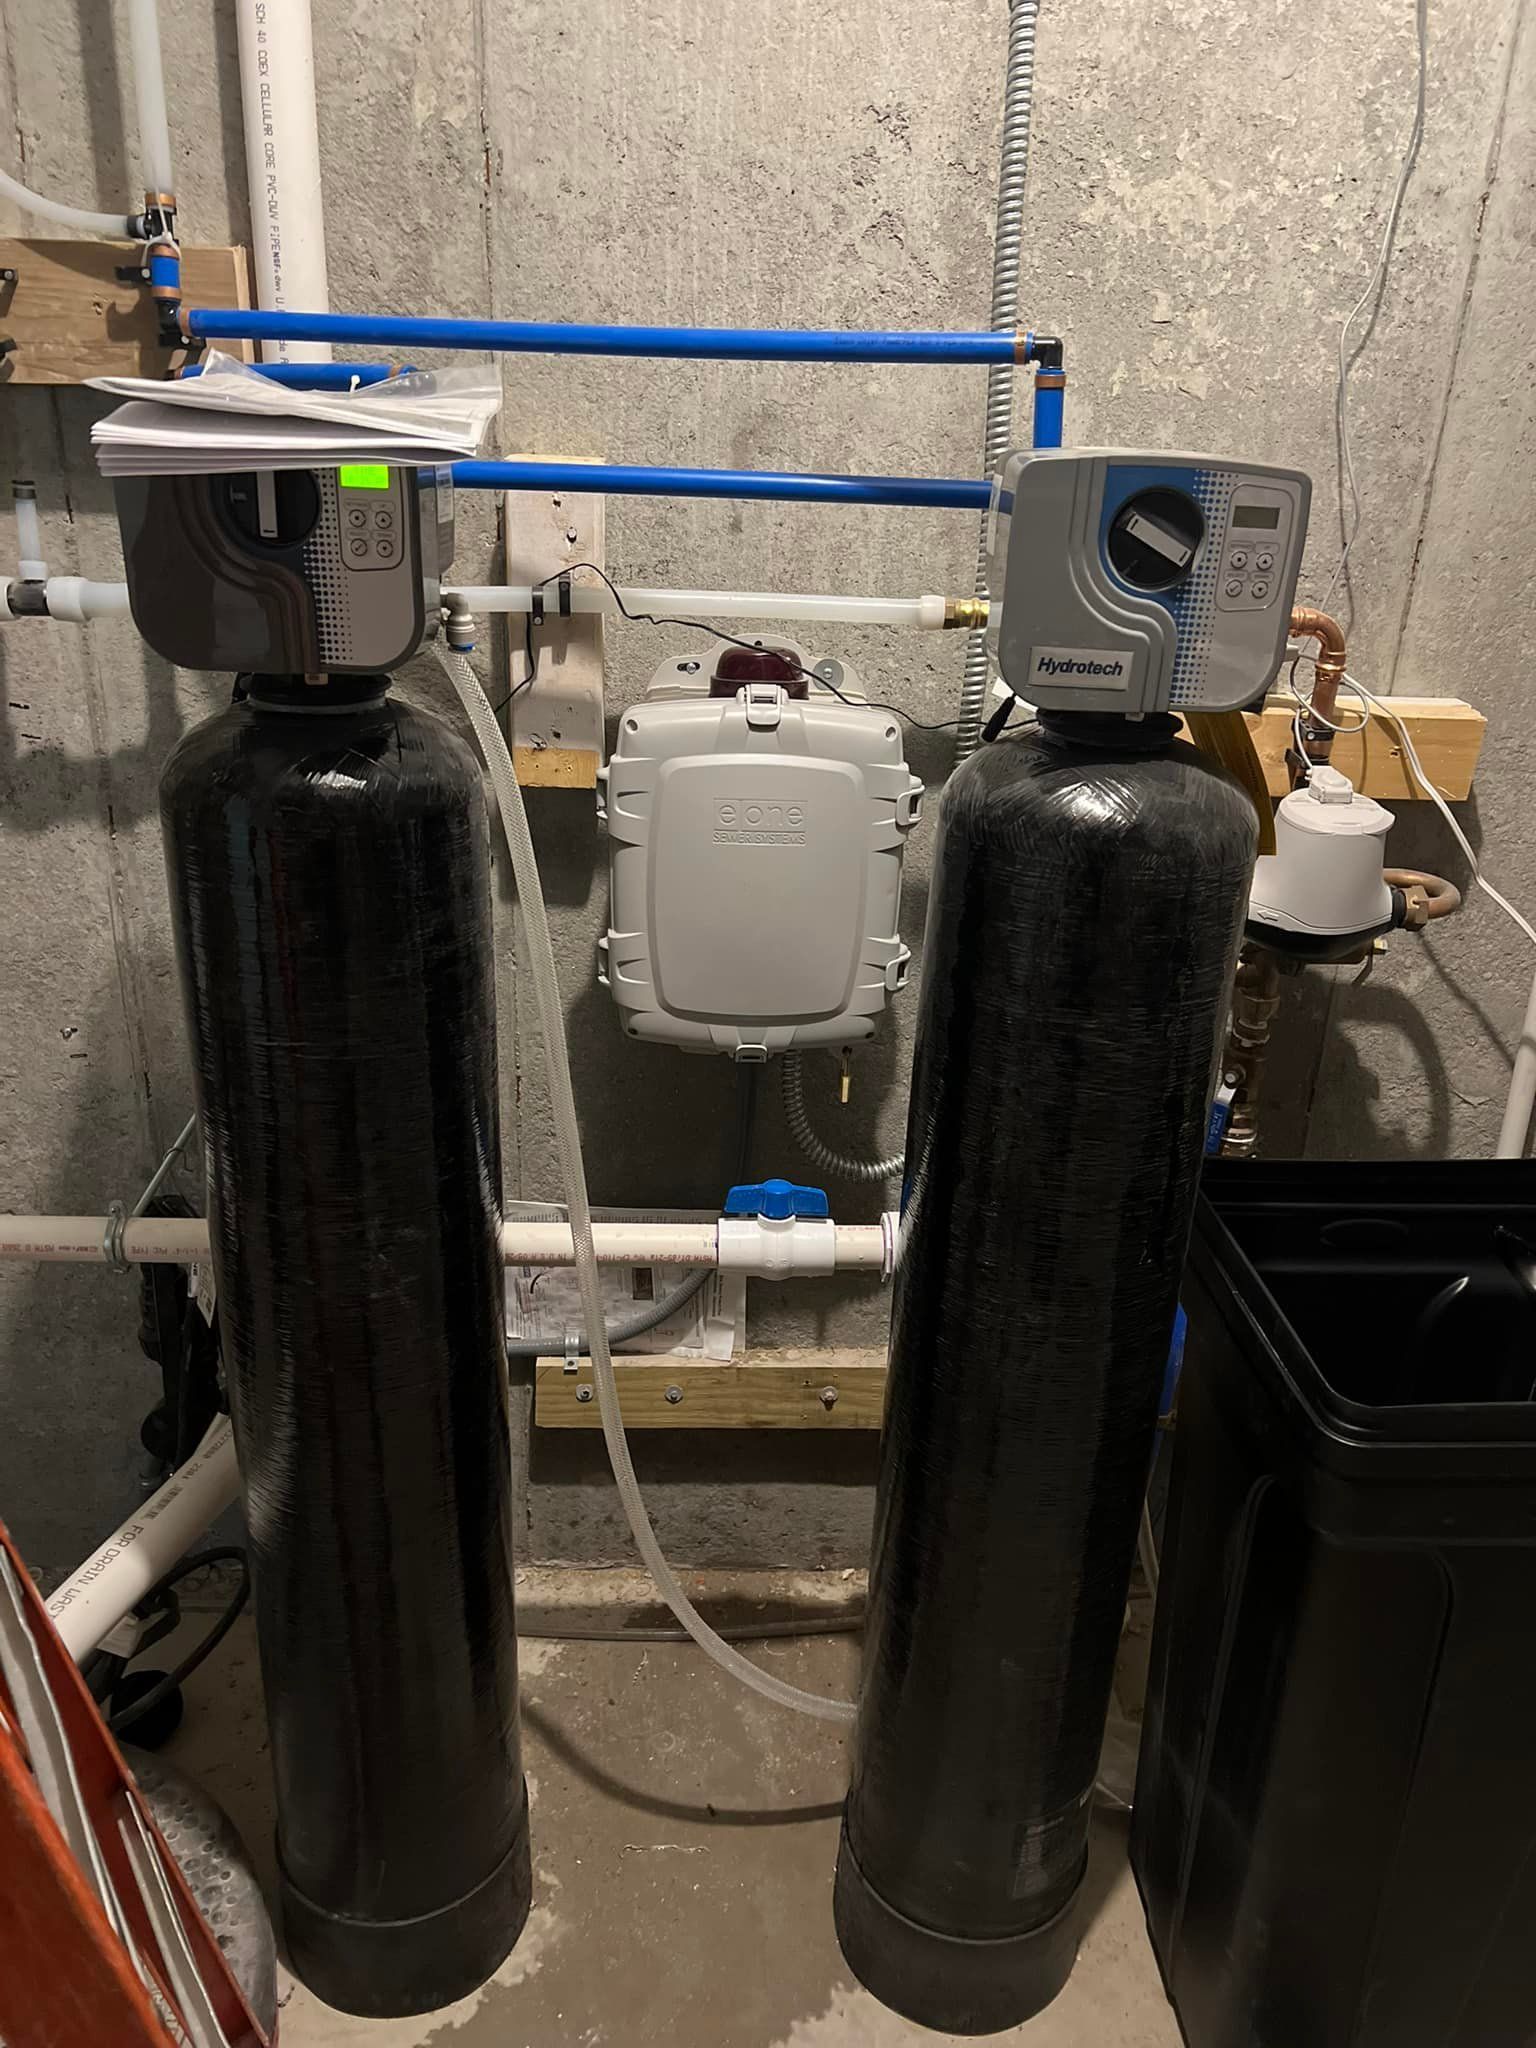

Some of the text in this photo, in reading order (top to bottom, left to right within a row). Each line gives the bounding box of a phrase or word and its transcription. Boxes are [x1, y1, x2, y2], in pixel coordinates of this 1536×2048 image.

[255, 3, 266, 24] SCH
[257, 30, 267, 44] 40
[258, 50, 269, 77] COEX
[260, 83, 274, 137] CELLULAR
[264, 142, 276, 169] CORE
[267, 174, 279, 220] PVC-DWV
[270, 225, 281, 250] PIPE
[1037, 657, 1124, 676] Hydrotech
[713, 831, 806, 845] SEWER SYSTEMS
[114, 1524, 144, 1549] FOR
